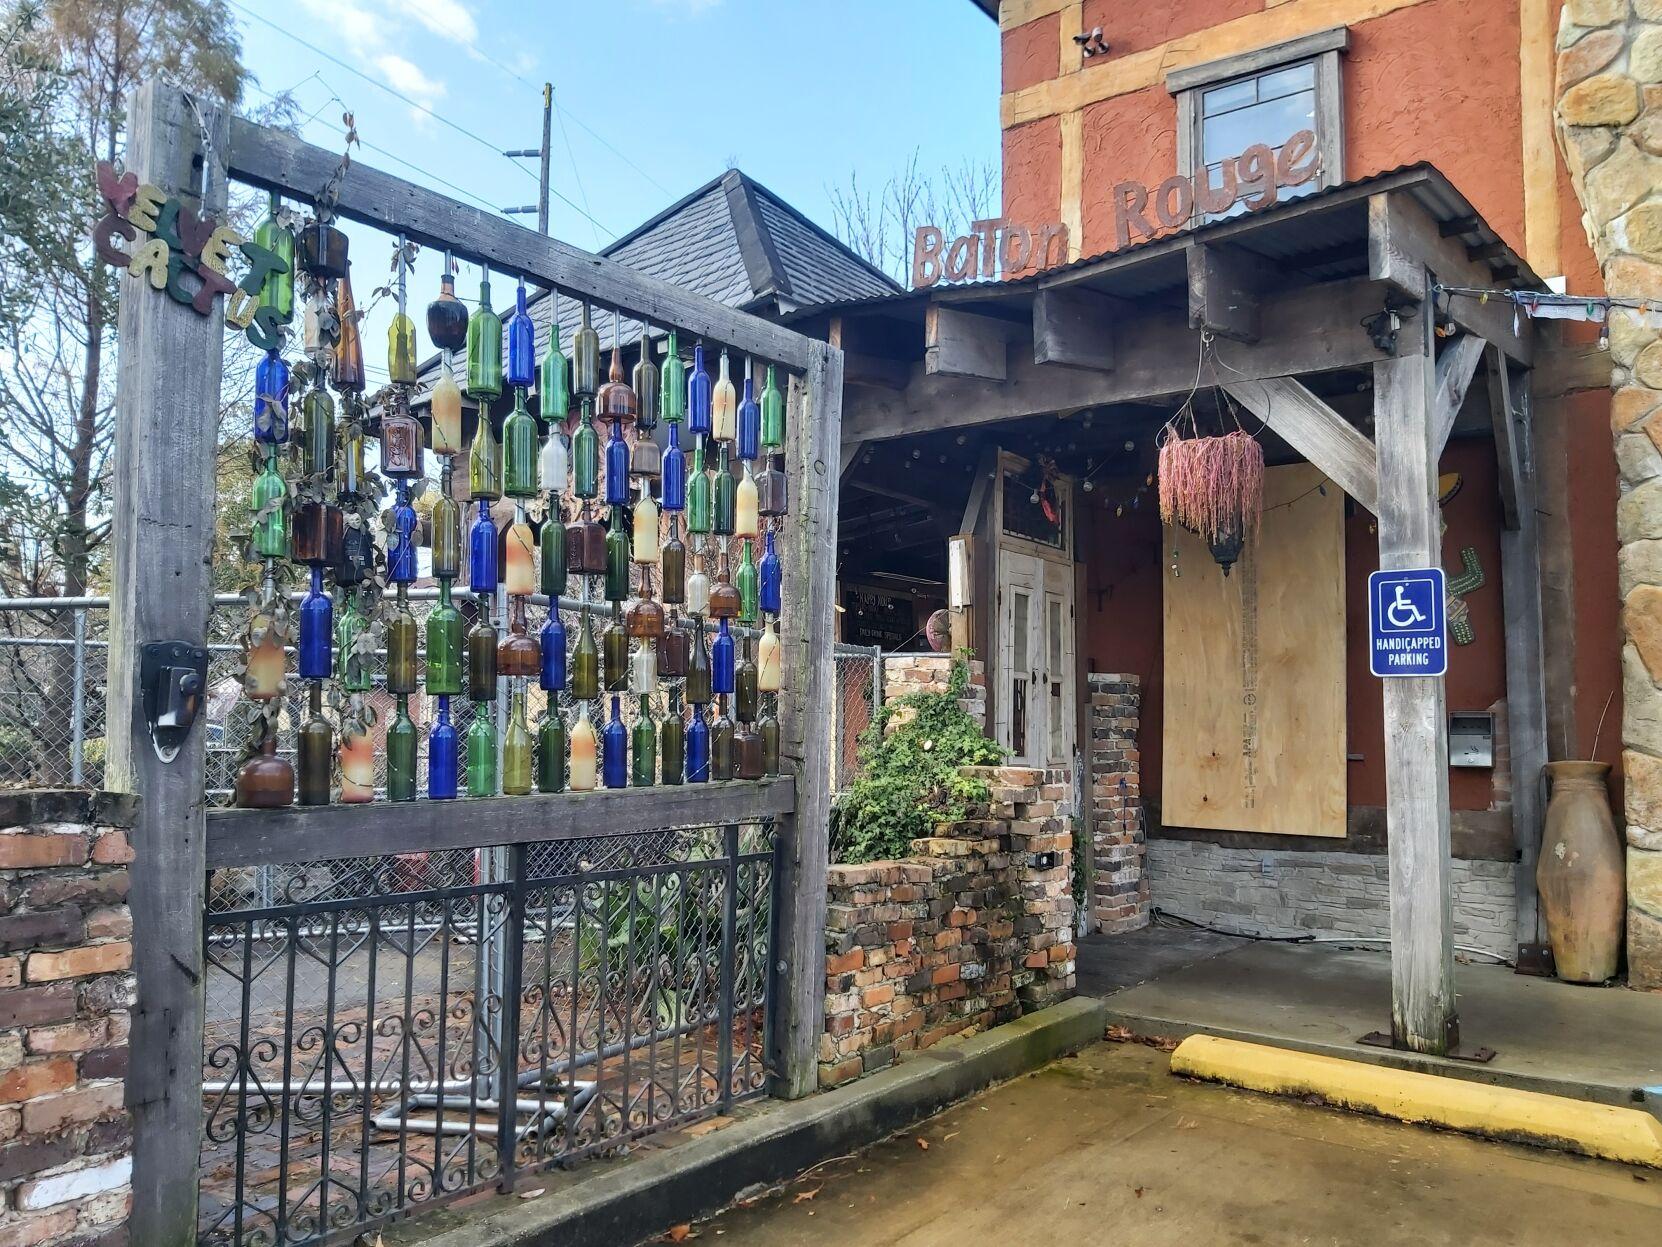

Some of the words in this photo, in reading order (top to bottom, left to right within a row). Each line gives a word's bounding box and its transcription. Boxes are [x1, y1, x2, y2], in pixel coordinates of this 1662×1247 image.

[96, 160, 289, 296] VELVET
[1113, 129, 1322, 248] Rouge
[94, 211, 292, 350] CACTUS
[1376, 637, 1441, 650] HANDICAPPED
[1388, 653, 1429, 666] PARKING
